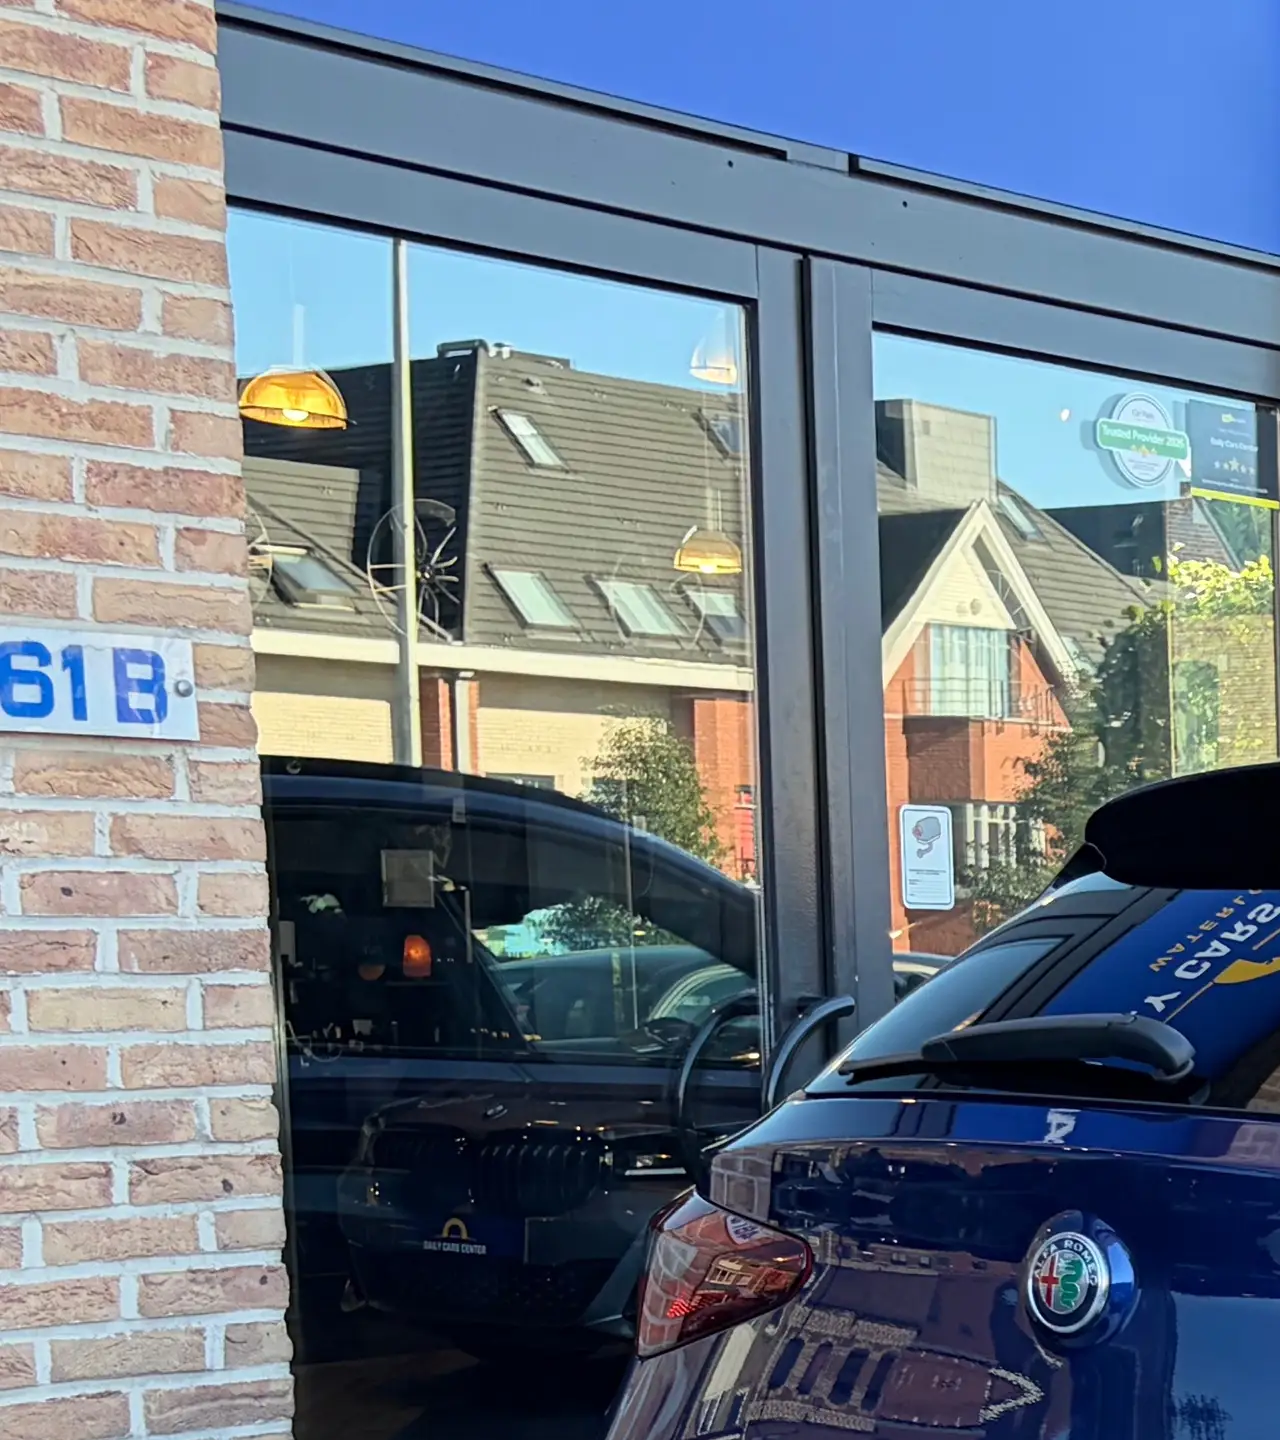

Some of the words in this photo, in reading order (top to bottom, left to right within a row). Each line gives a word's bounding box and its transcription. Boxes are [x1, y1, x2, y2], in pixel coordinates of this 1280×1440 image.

[0, 640, 88, 721] 61
[112, 646, 168, 724] B
[1034, 1243, 1059, 1281] ALFA
[1063, 1239, 1098, 1287] ROMEO
